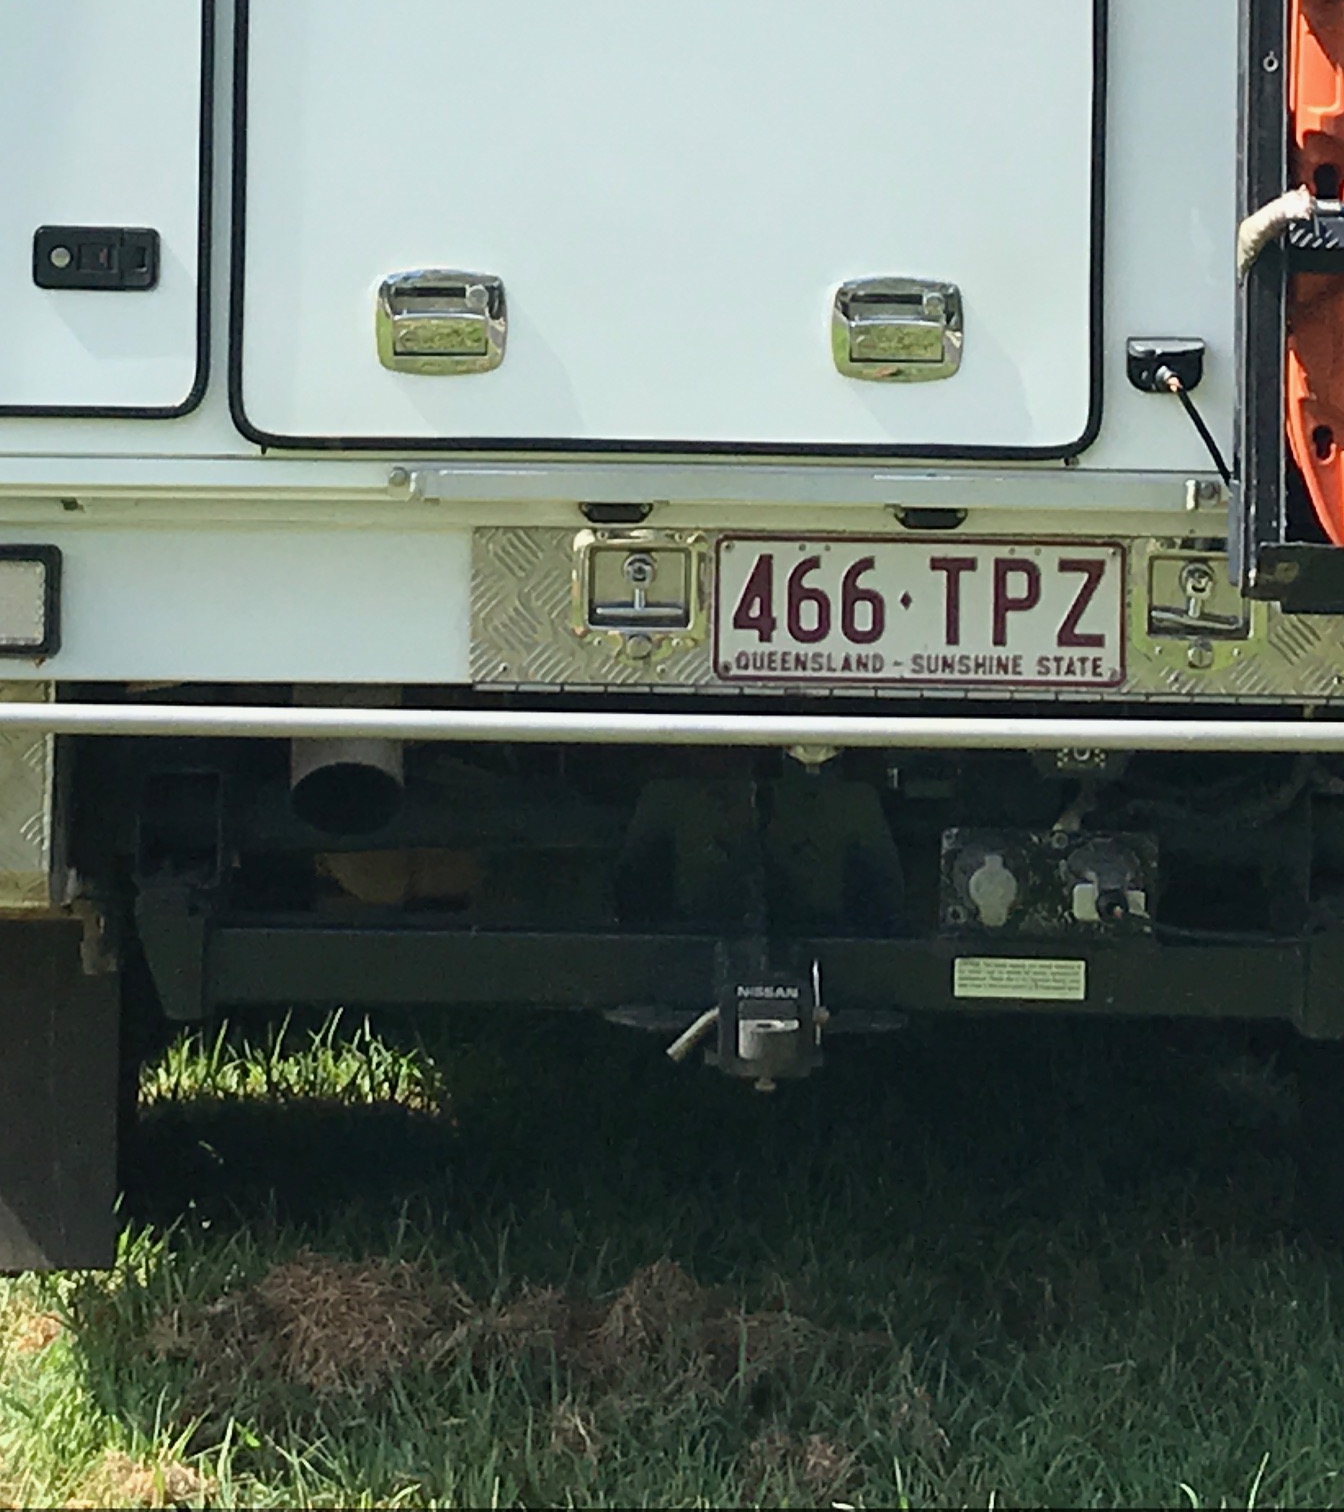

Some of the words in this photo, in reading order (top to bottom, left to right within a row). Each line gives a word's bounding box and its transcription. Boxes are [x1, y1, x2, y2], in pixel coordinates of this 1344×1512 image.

[735, 651, 883, 673] QUEENSLAND
[910, 653, 1023, 675] SUNSHINE
[1036, 655, 1103, 678] STATE
[737, 986, 799, 998] NISSAN
